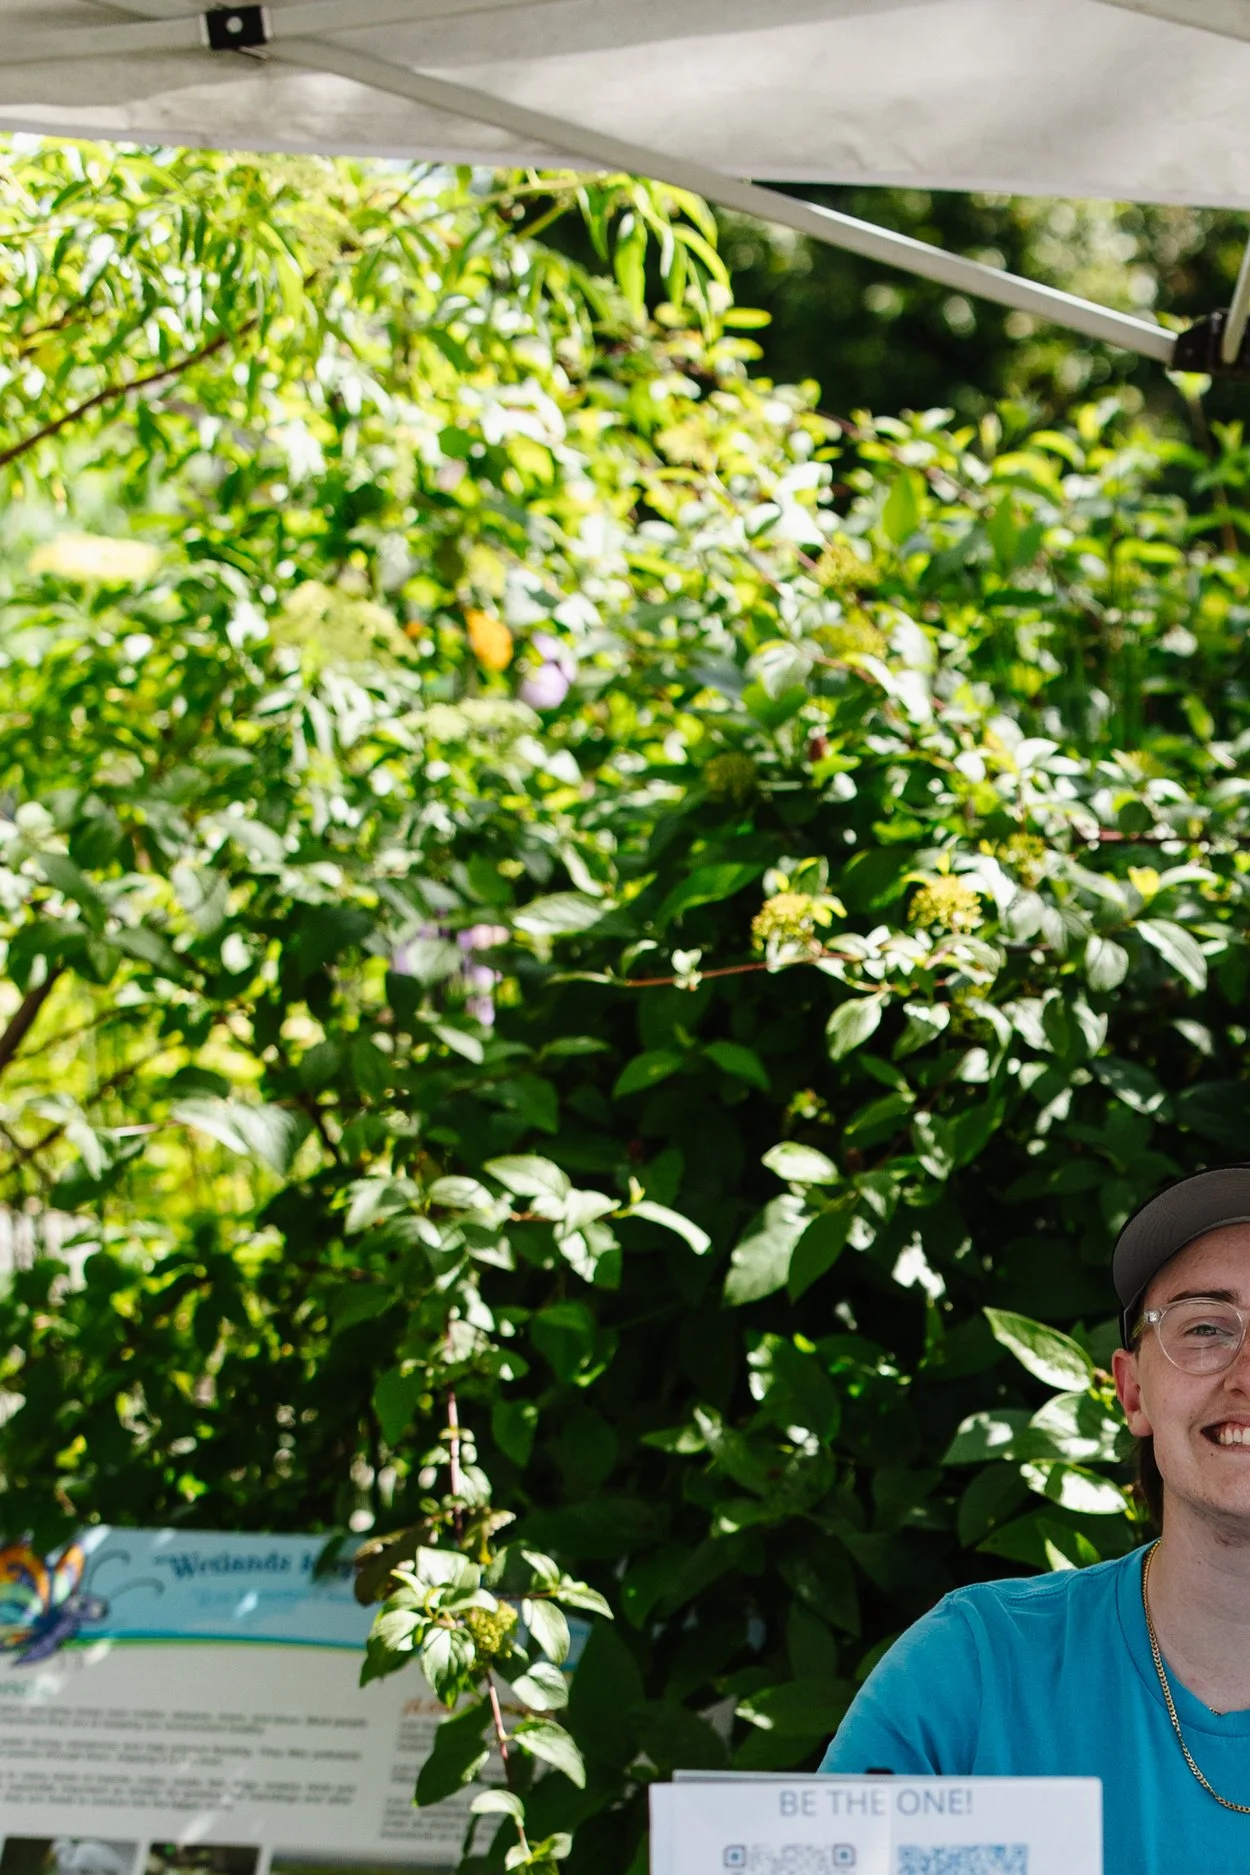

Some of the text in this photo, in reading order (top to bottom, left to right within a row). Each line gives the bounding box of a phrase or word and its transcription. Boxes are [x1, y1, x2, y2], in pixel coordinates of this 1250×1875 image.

[779, 1788, 973, 1817] BE THE ONE!
